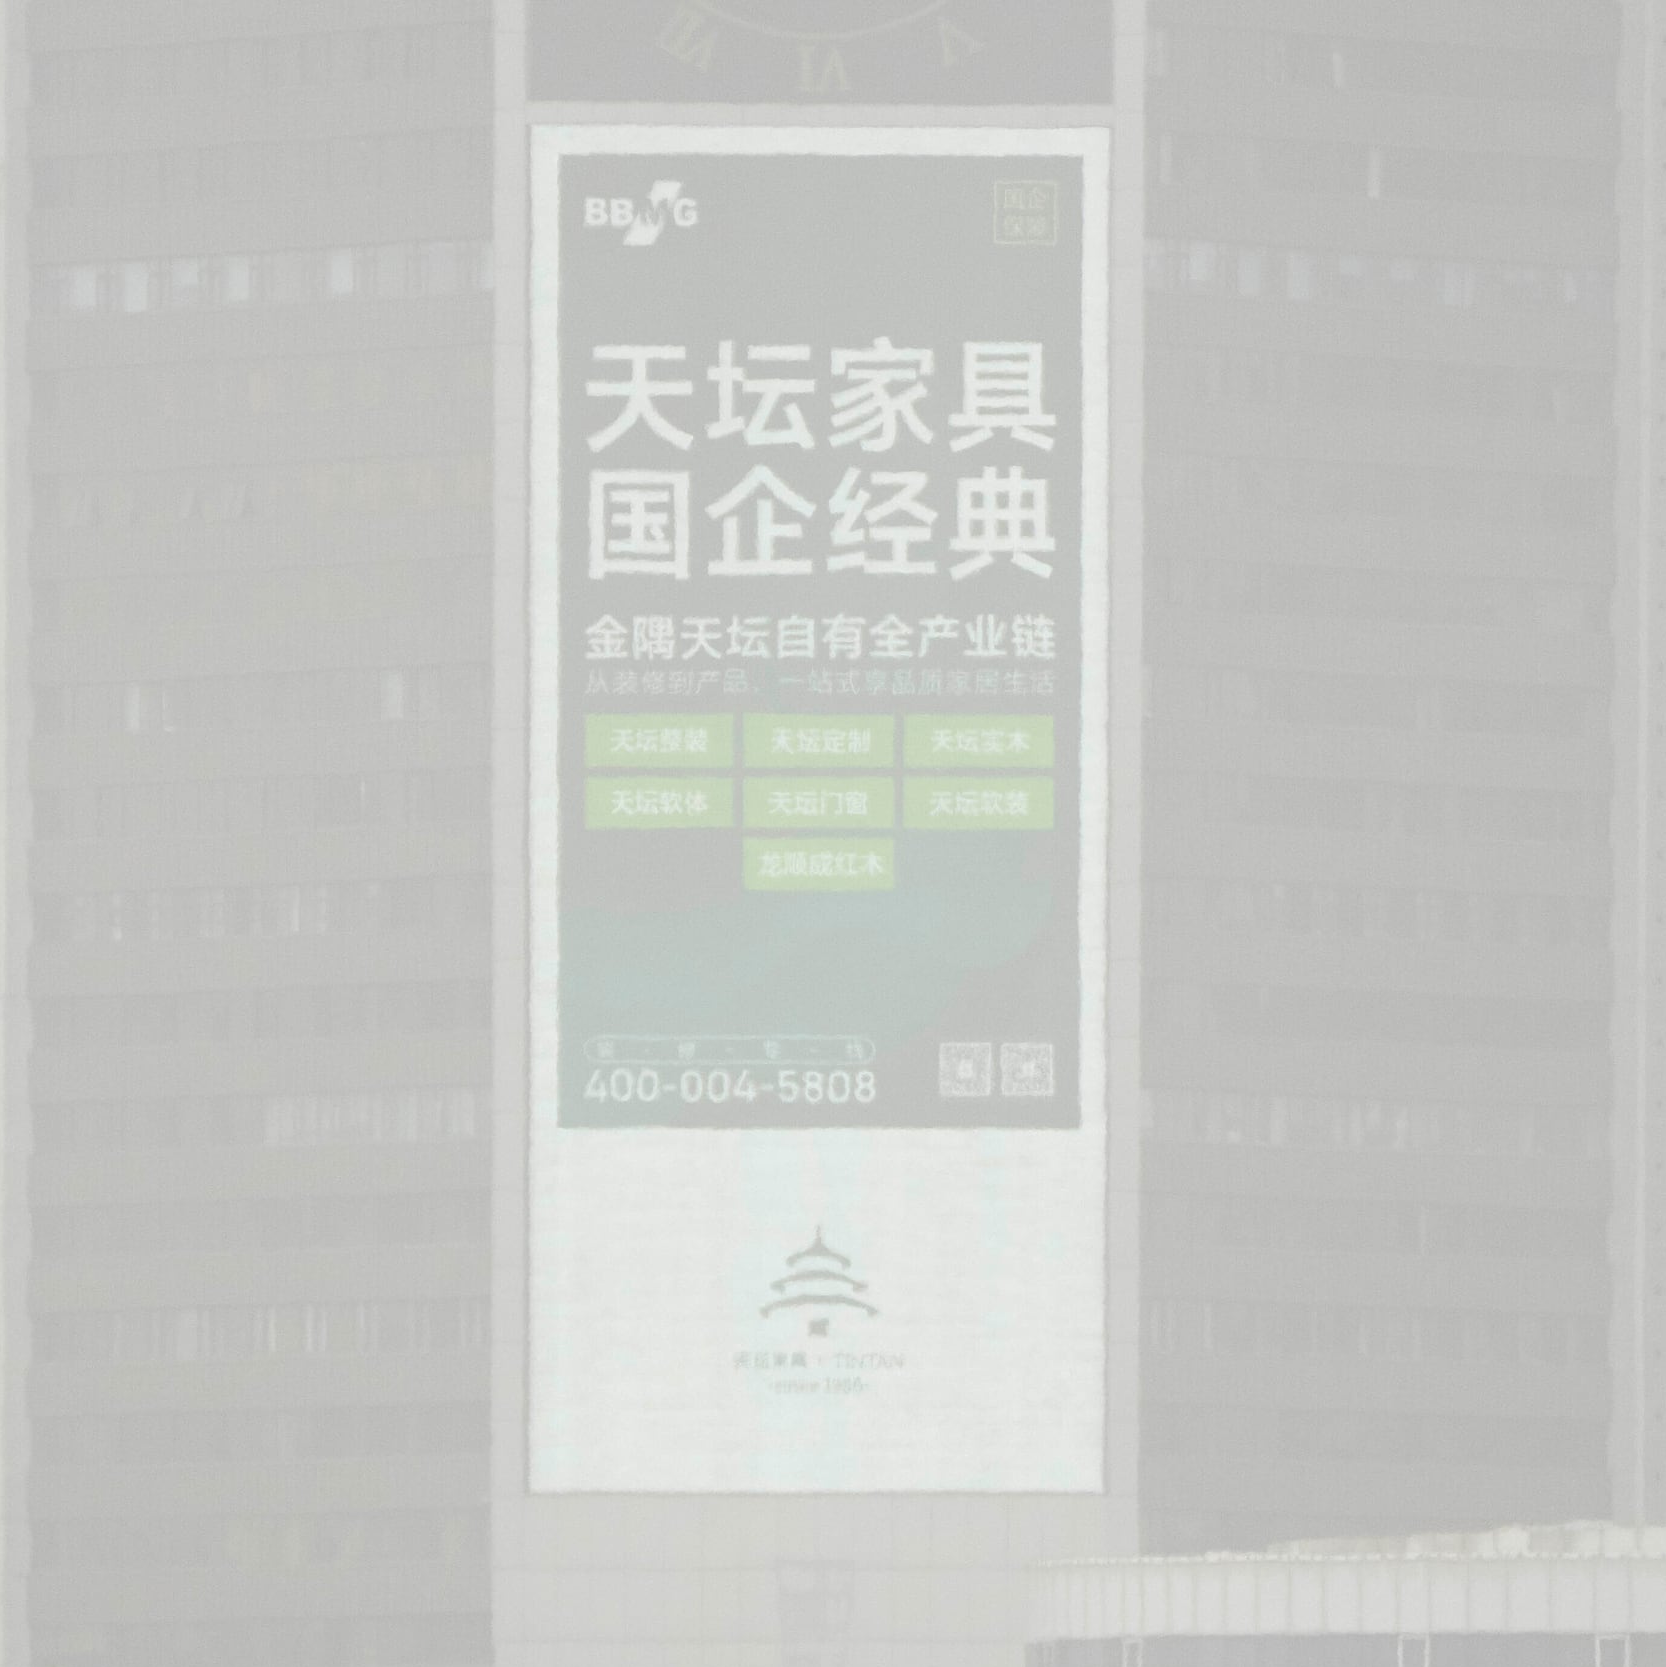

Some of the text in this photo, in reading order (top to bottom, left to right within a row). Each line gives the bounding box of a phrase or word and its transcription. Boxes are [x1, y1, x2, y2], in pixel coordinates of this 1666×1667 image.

[585, 337, 1056, 453] 天坛家具
[587, 464, 1056, 581] 国企经典
[584, 614, 1056, 660] 金隅天坛自有全产业链
[771, 728, 872, 754] 天坛定制
[930, 728, 1031, 754] 天坛实木
[610, 790, 709, 816] 天坛软体
[768, 790, 868, 817] 天坛门窗
[585, 1068, 876, 1103] 400-004-5808
